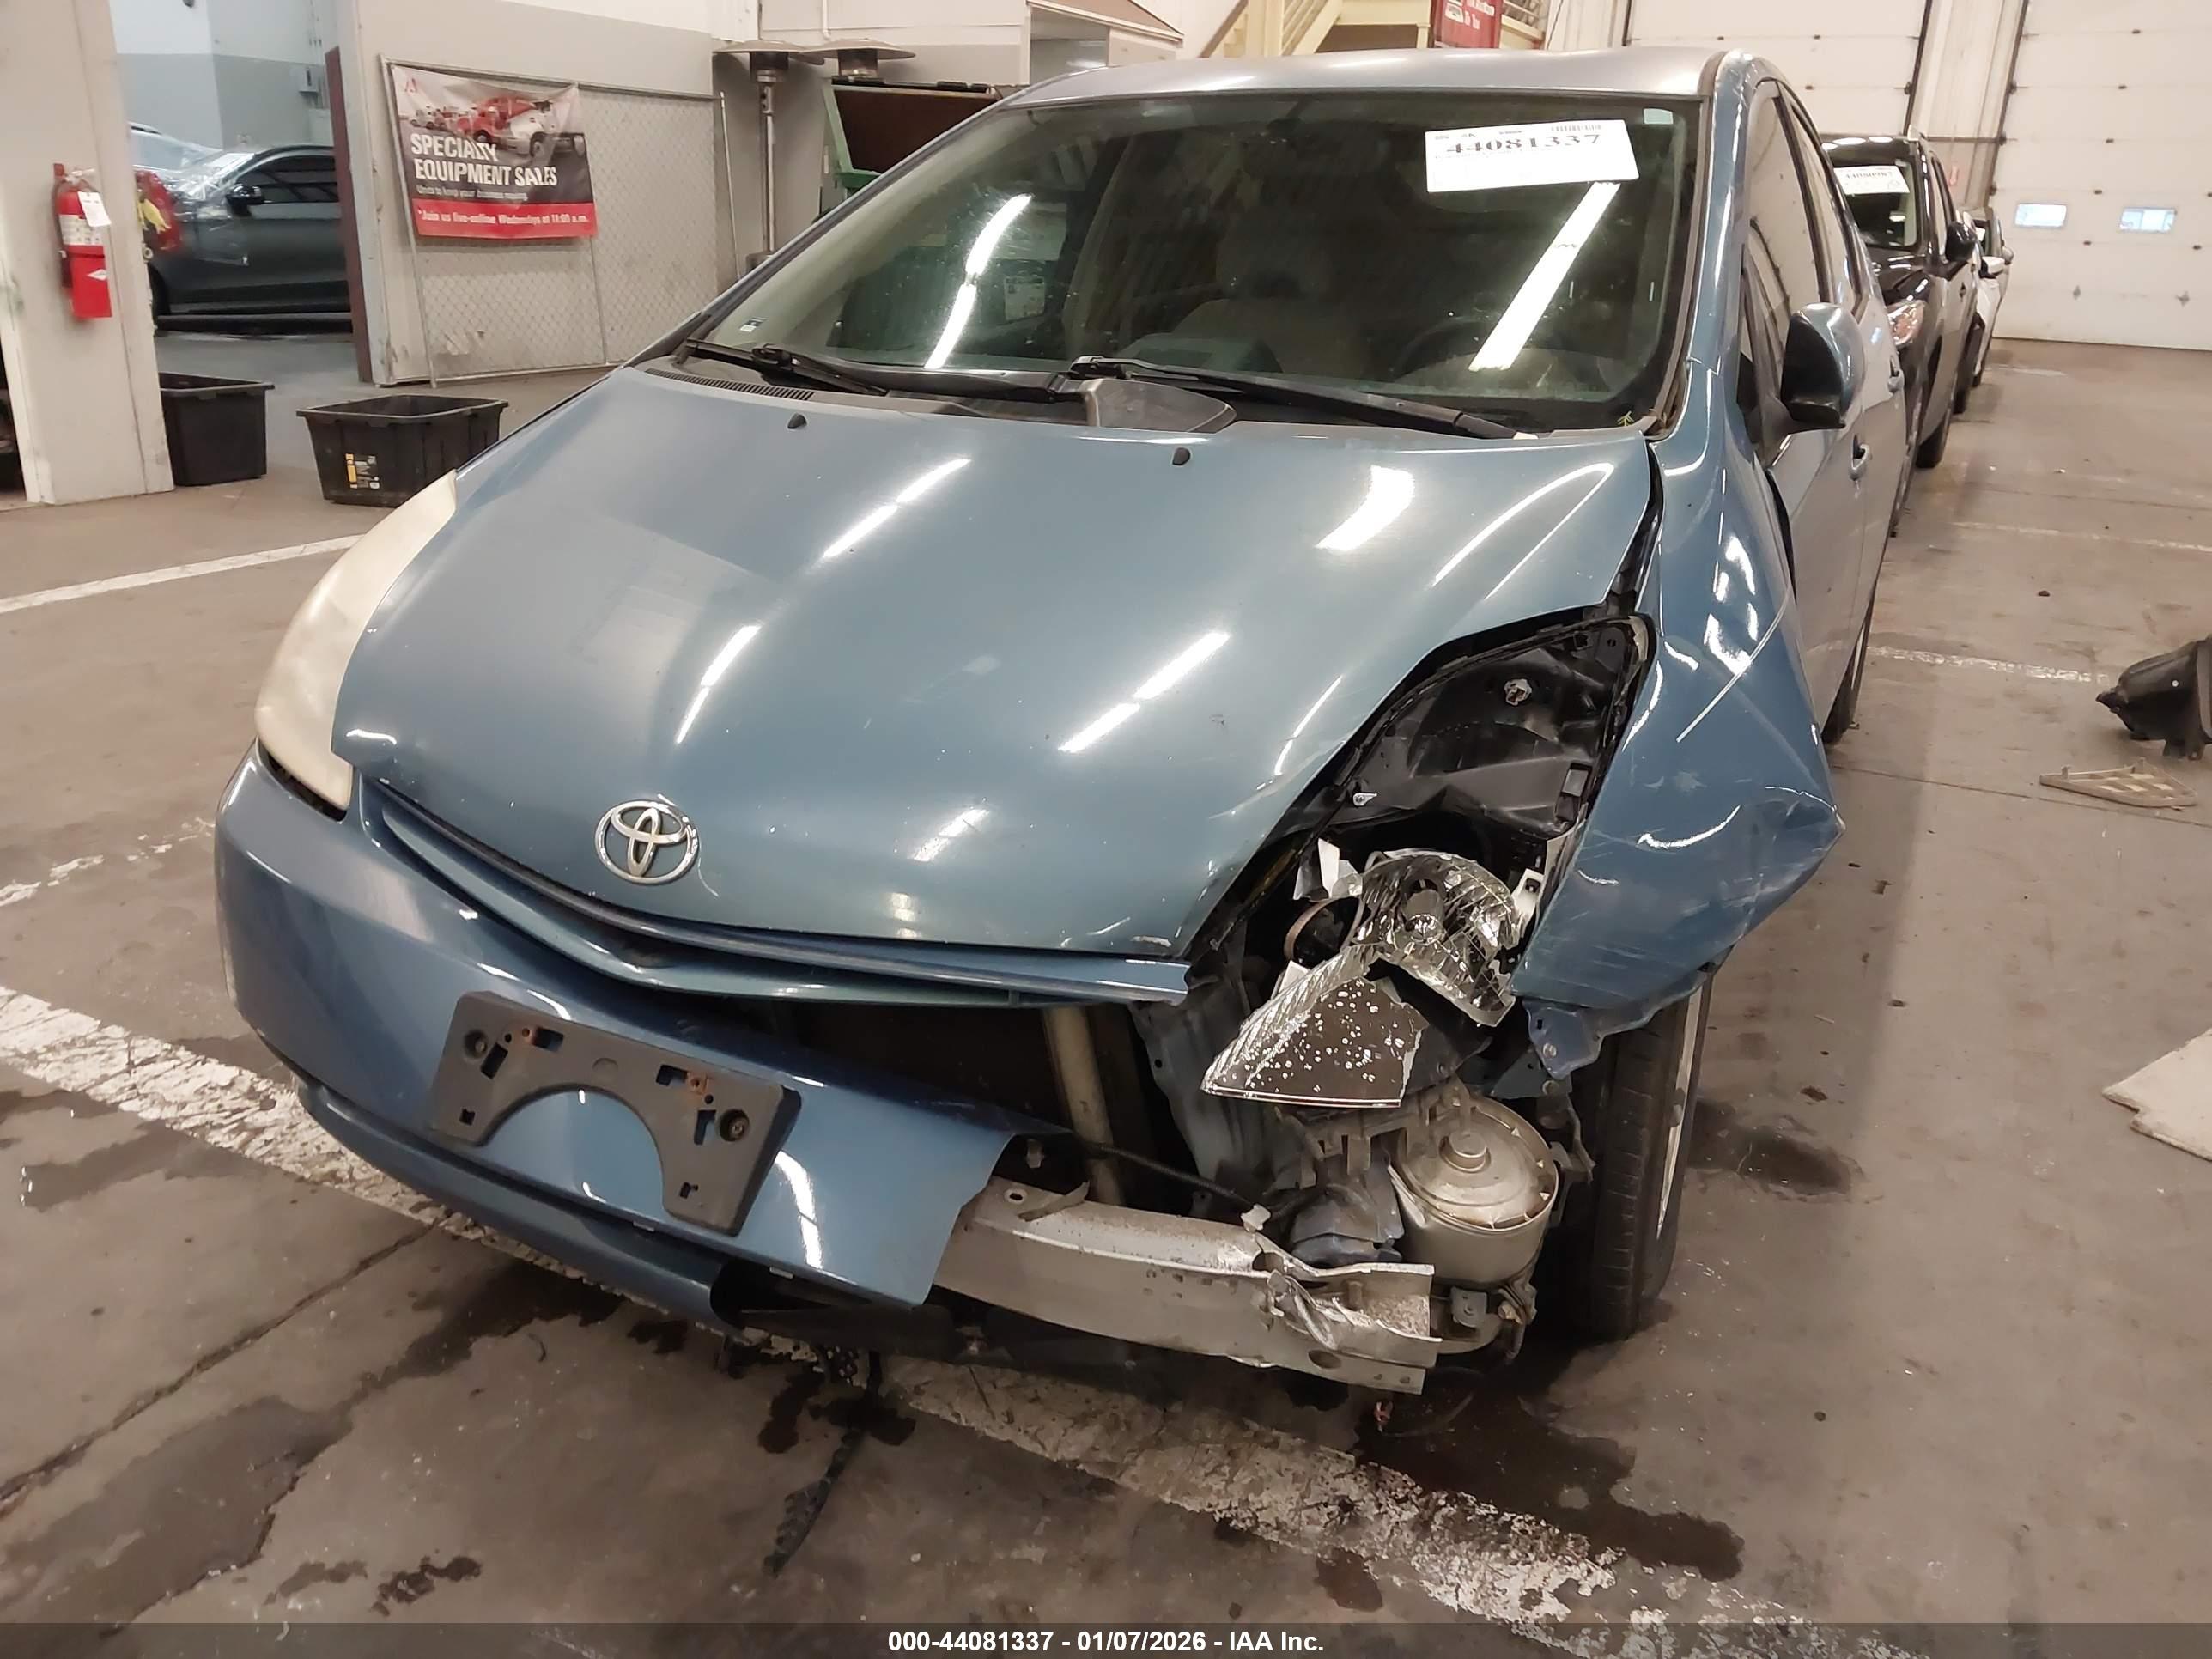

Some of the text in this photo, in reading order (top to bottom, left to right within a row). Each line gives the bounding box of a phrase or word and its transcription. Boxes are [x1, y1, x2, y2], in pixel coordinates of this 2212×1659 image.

[410, 133, 499, 161] SPECIALTY
[1446, 134, 1600, 154] 44081337
[415, 159, 557, 186] EQUIPMENT SALES
